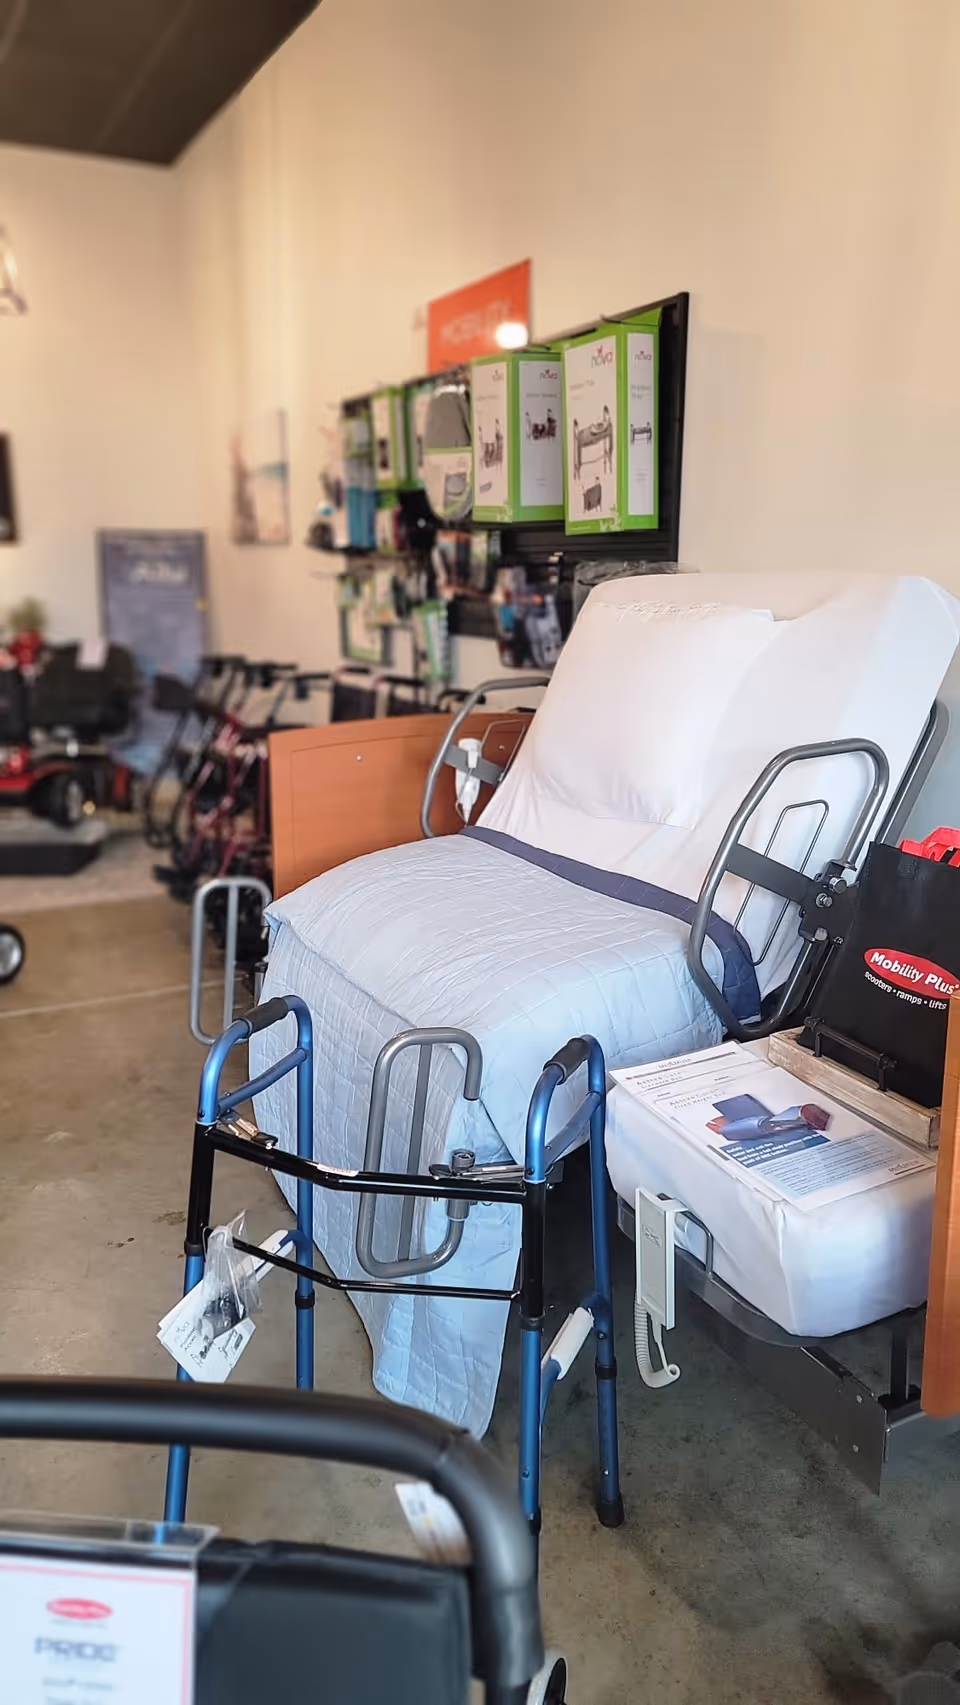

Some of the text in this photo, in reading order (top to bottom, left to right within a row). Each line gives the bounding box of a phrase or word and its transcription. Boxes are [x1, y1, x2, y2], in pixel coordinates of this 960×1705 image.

[864, 971, 947, 1010] scooters ramps lifts
[870, 951, 955, 995] Mobility Plus
